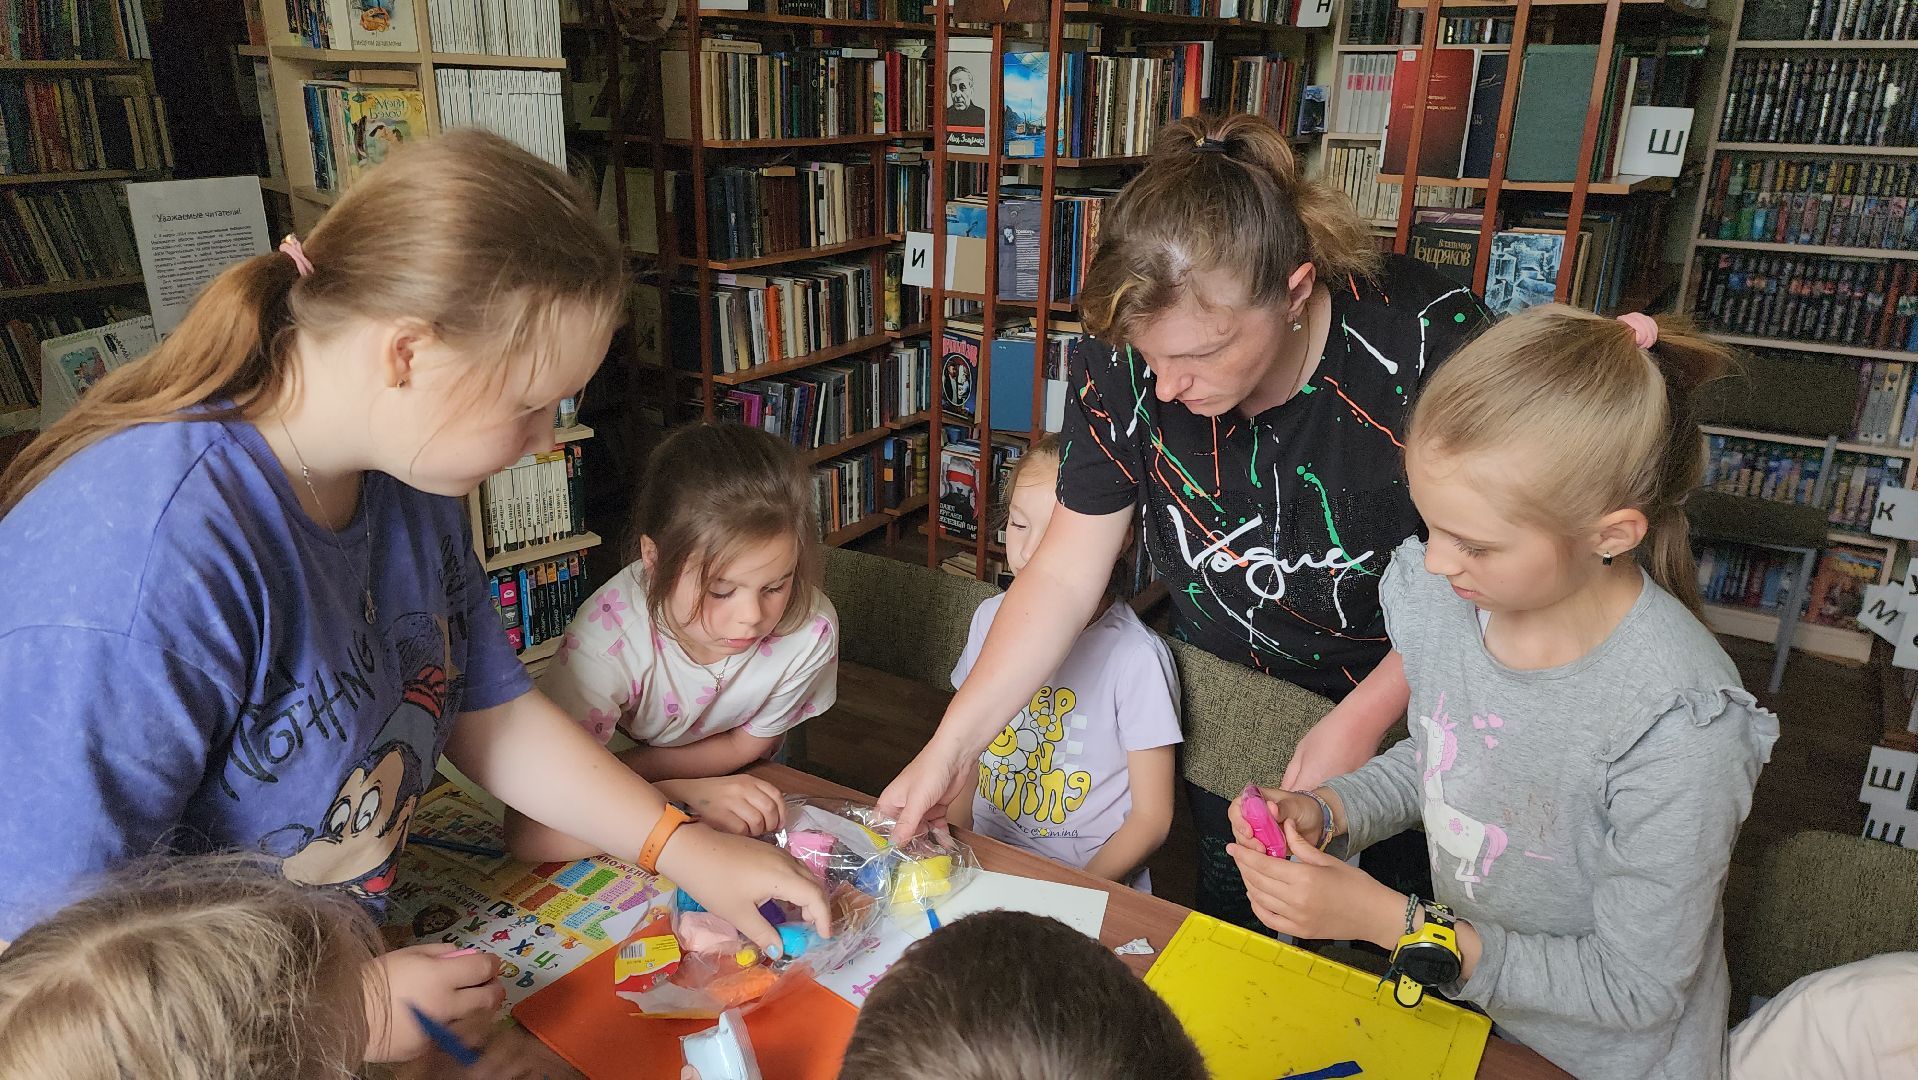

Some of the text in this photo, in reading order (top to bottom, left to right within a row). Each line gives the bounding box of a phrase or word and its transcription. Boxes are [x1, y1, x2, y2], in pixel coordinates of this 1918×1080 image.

[1648, 128, 1684, 155] Ш
[912, 247, 925, 268] И
[1877, 501, 1896, 521] К
[1167, 504, 1374, 600] Vogue
[1868, 599, 1898, 626] М
[228, 629, 376, 783] NOTHING
[1869, 766, 1905, 791] Ш
[979, 761, 1092, 825] miling
